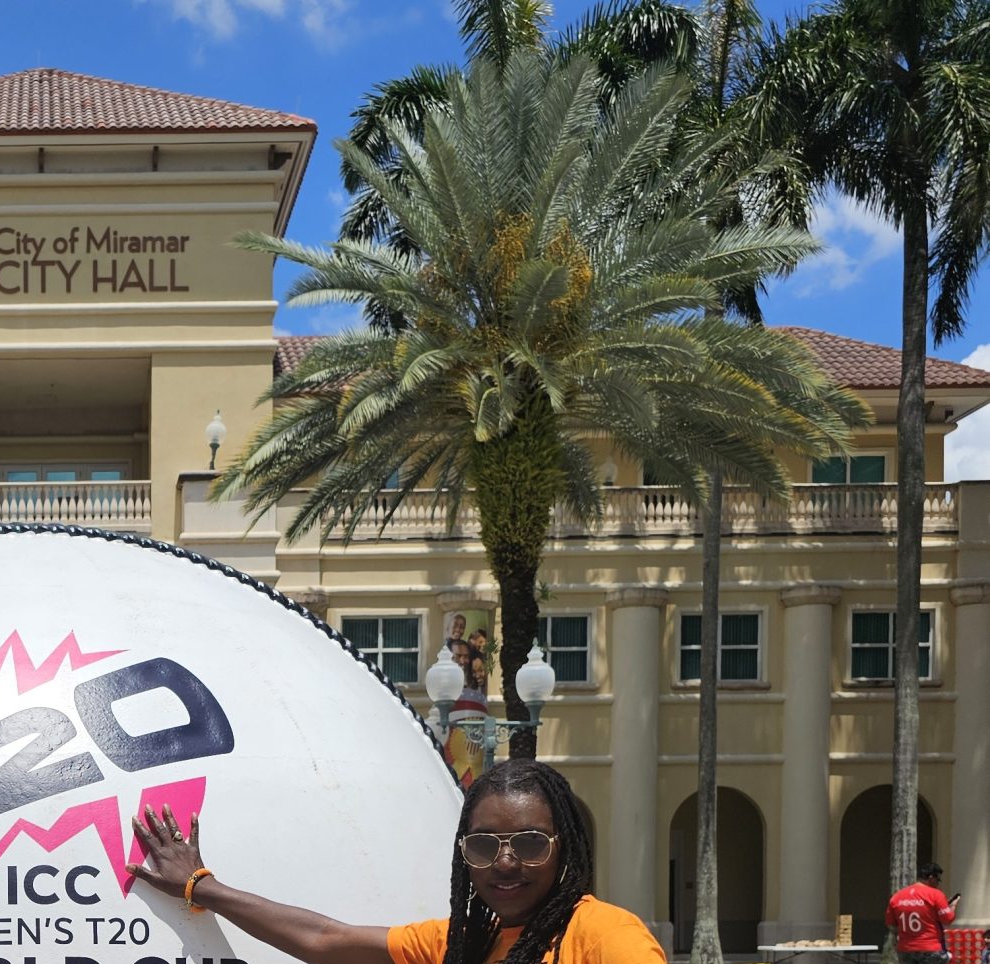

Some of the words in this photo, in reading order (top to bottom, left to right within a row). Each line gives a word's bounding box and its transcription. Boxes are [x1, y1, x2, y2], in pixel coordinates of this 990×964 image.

[53, 227, 79, 254] of
[86, 226, 190, 254] Miramar
[93, 259, 190, 293] HALL
[8, 865, 100, 904] ICC
[86, 917, 150, 946] T20
[898, 911, 921, 932] 16
